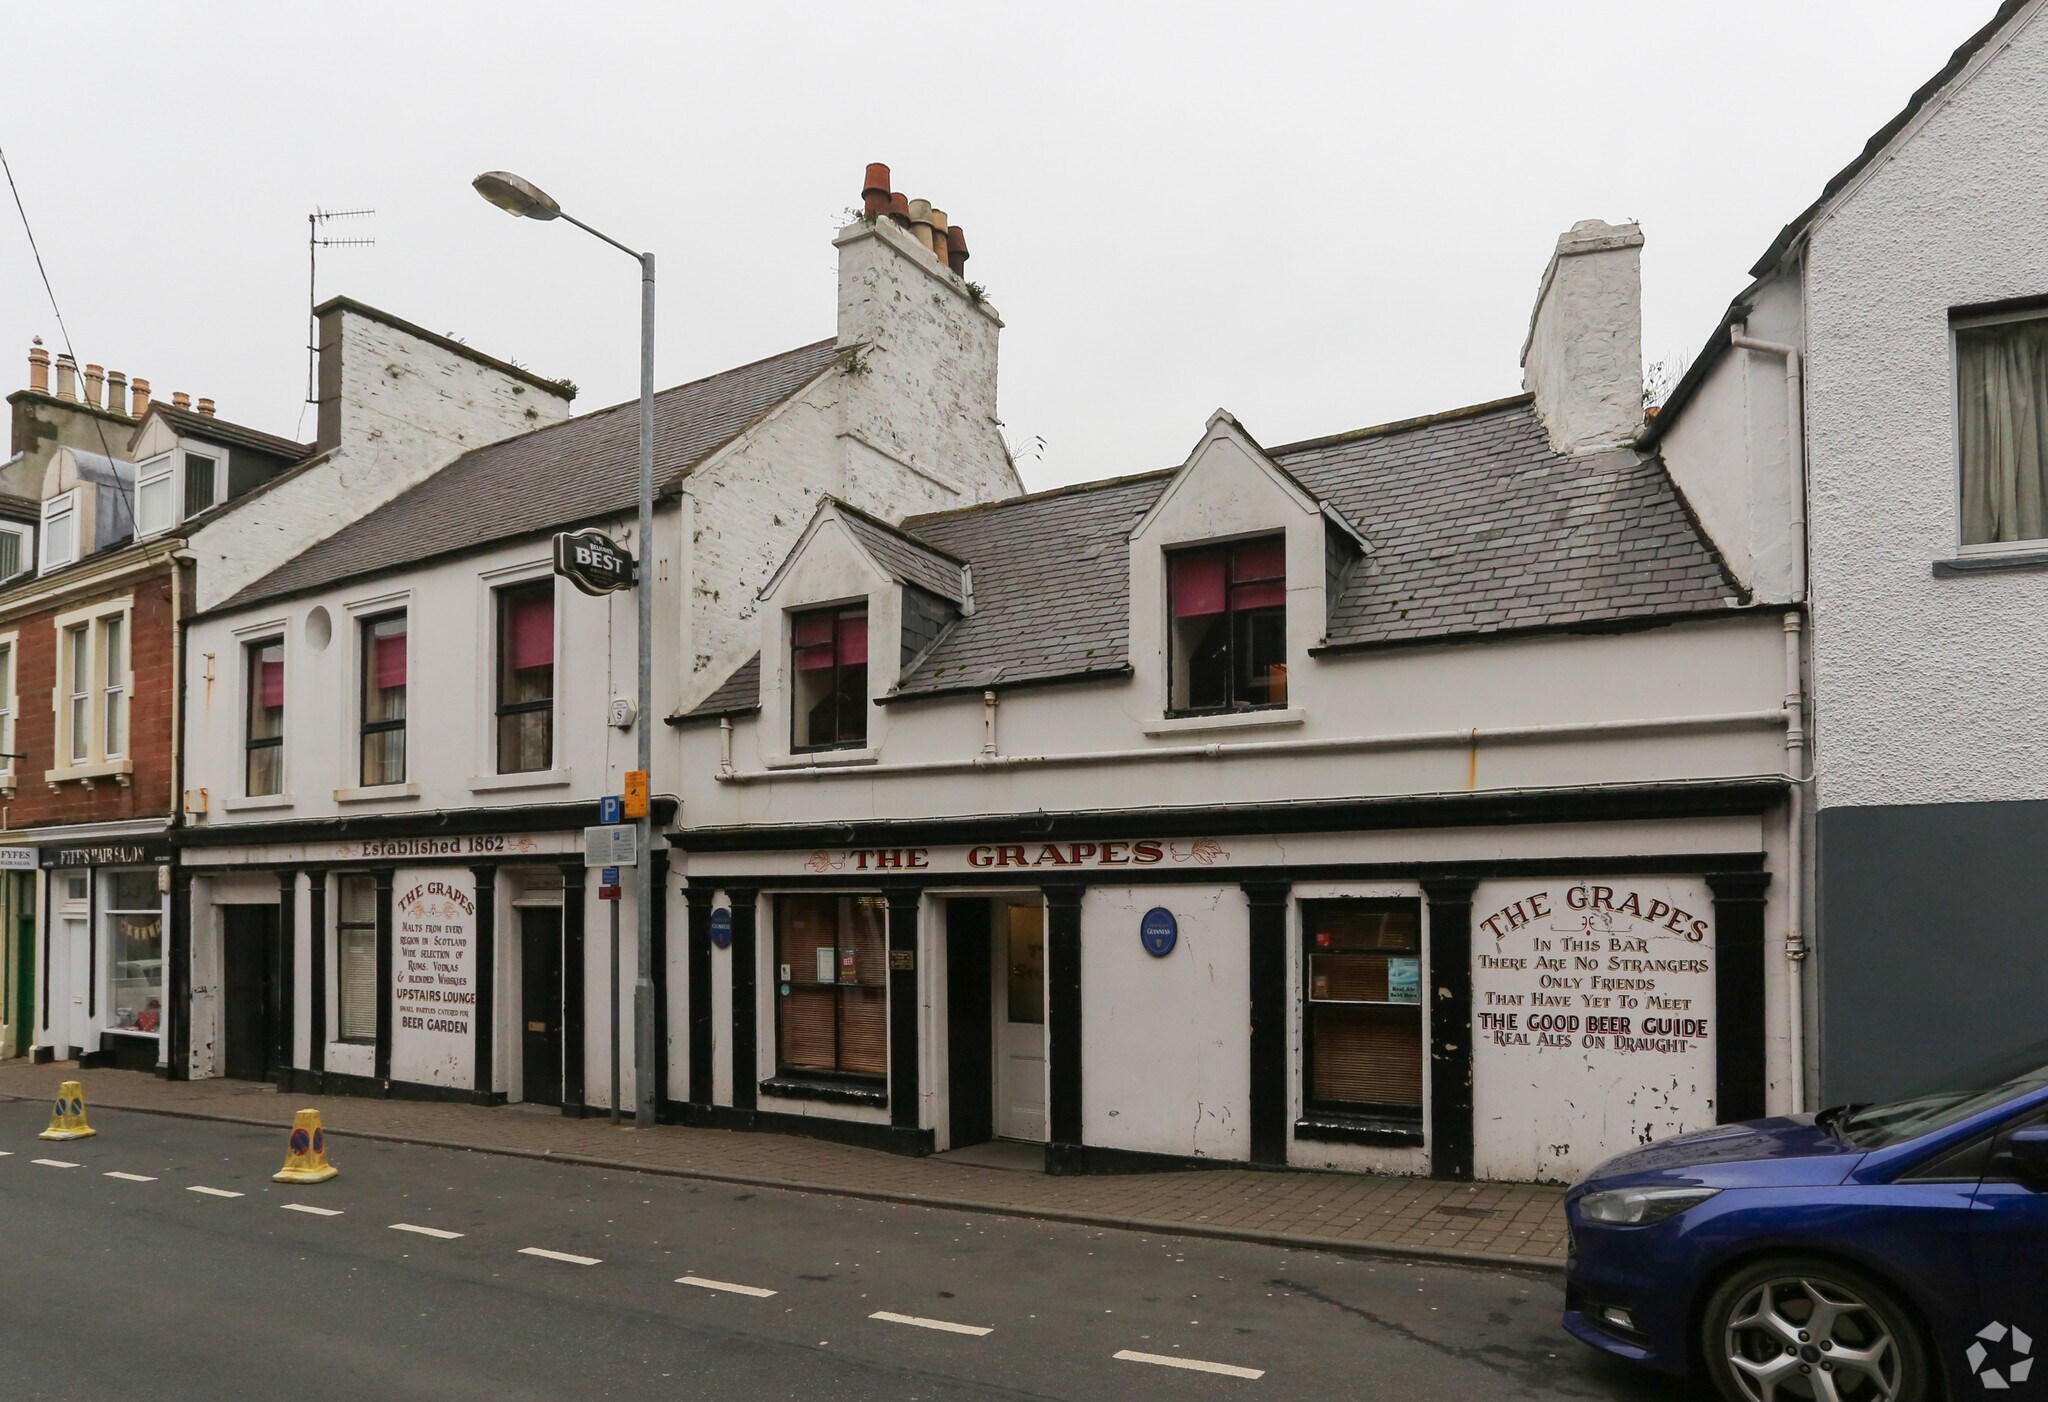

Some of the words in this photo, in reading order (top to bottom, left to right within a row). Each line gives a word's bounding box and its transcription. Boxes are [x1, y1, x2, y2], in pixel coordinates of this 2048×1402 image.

[575, 546, 623, 573] BEST
[605, 799, 616, 820] P
[1, 850, 31, 859] FYFES
[362, 838, 461, 856] Established
[468, 836, 504, 853] 1862
[850, 848, 929, 870] THE
[967, 840, 1164, 868] GRAPES
[398, 884, 424, 912] THE
[427, 882, 475, 916] GRAPES
[1480, 892, 1551, 941] THE
[1566, 886, 1708, 943] GRAPES
[1533, 938, 1551, 952] IN
[1560, 937, 1601, 952] THIS
[1609, 938, 1649, 954] BAR
[1478, 955, 1527, 972] THERE
[1534, 956, 1567, 972] ARE
[1575, 956, 1599, 971] NO
[1608, 956, 1709, 973] STRANGERS
[1539, 974, 1583, 989] ONLY
[1591, 975, 1655, 991] FRIENDS
[397, 988, 441, 1002] UPSTAIRS
[443, 991, 475, 1006] LOUNGE
[1485, 992, 1524, 1006] THAT
[1531, 992, 1571, 1007] HAVE
[1581, 994, 1611, 1008] YET
[1618, 995, 1638, 1009] TO
[1645, 996, 1692, 1010] MEET
[402, 1016, 423, 1030] BEER
[427, 1018, 468, 1034] GARDEN
[1478, 1012, 1518, 1030] THE
[1527, 1014, 1579, 1033] GOOD
[1586, 1016, 1631, 1034] BEER
[1642, 1018, 1708, 1038] GUIDE
[1494, 1030, 1530, 1047] REAL
[1536, 1032, 1572, 1047] ALES
[1582, 1034, 1605, 1049] ON
